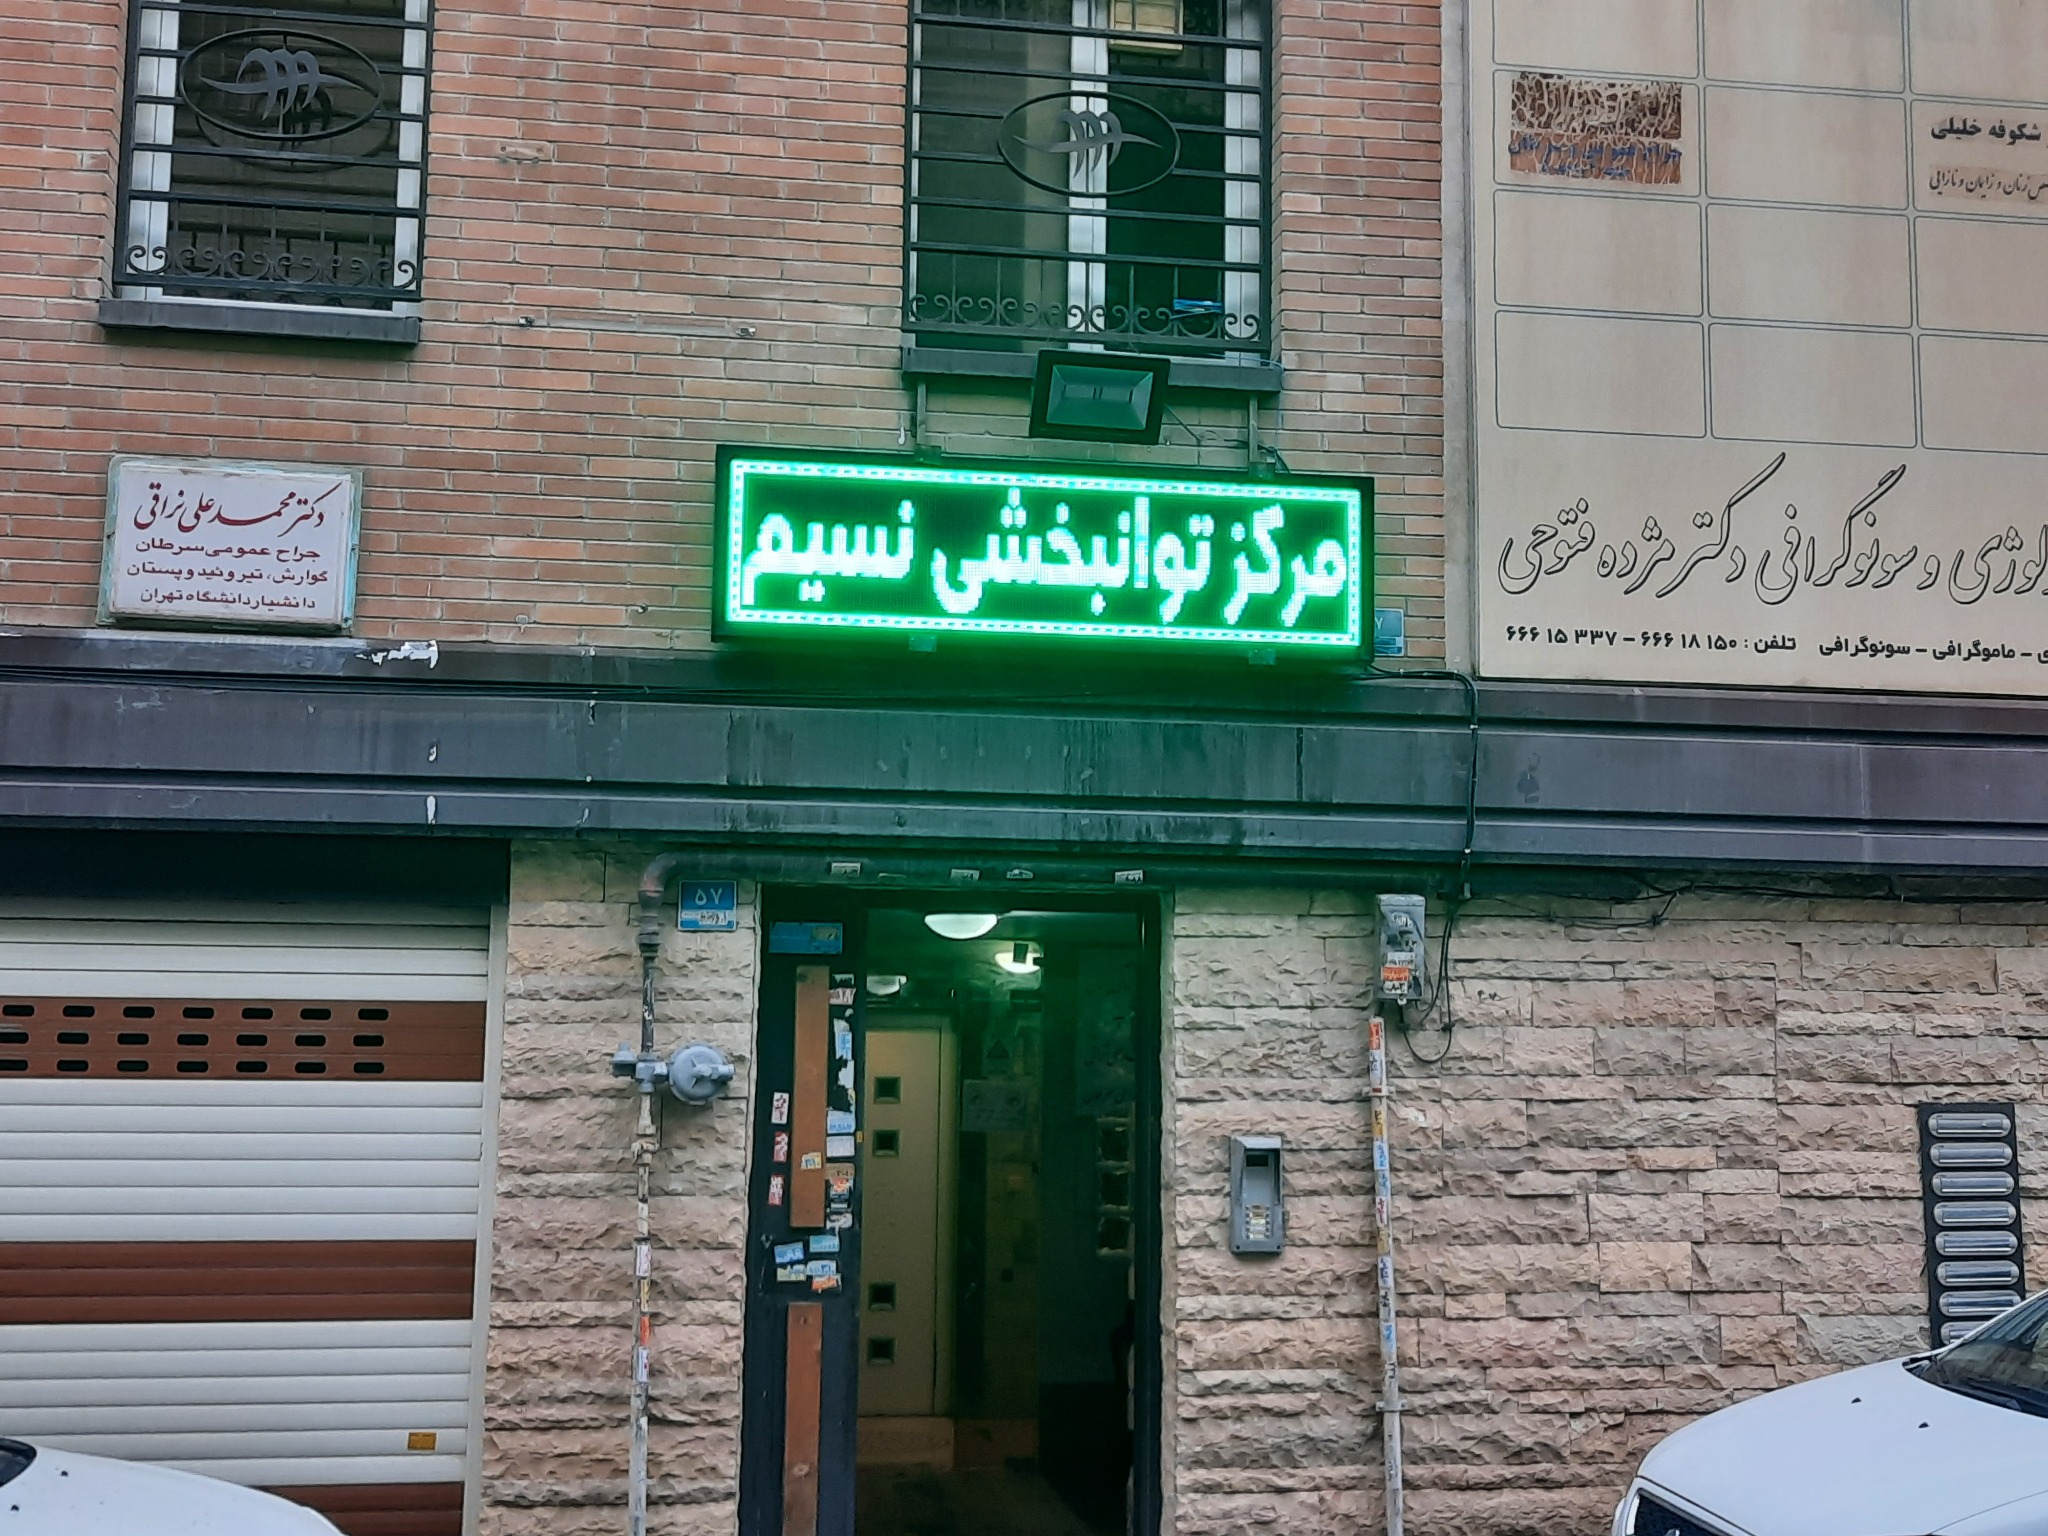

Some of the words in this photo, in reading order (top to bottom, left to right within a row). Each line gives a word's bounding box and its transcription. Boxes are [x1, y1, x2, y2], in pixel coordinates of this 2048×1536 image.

[1930, 116, 1982, 140] خلیلی
[1986, 119, 2042, 146] شکوفه
[133, 481, 186, 530] نراقی
[177, 492, 216, 533] علی
[207, 490, 297, 527] محمد
[277, 481, 343, 538] دکتر
[1654, 451, 1787, 599] دکتر
[1755, 463, 1918, 606] سونوگرافی
[135, 537, 205, 556] سرطان
[205, 546, 272, 559] عمومی
[276, 545, 321, 563] جراح
[741, 498, 915, 607] نسیم
[933, 486, 1213, 625] توانبخشی
[1497, 497, 1596, 595] فتوحی
[1596, 515, 1676, 596] مژده
[126, 560, 183, 582] پستان
[183, 567, 195, 581] و
[1223, 502, 1348, 627] مرکز
[1916, 554, 1940, 591] و
[140, 587, 184, 604] تهران
[185, 590, 251, 606] دانشگاه
[249, 594, 316, 614] دانشیار
[1818, 634, 1911, 657] سونوگرافی
[1932, 639, 2016, 662] ماموگرافی
[694, 887, 723, 907] ۵۷
